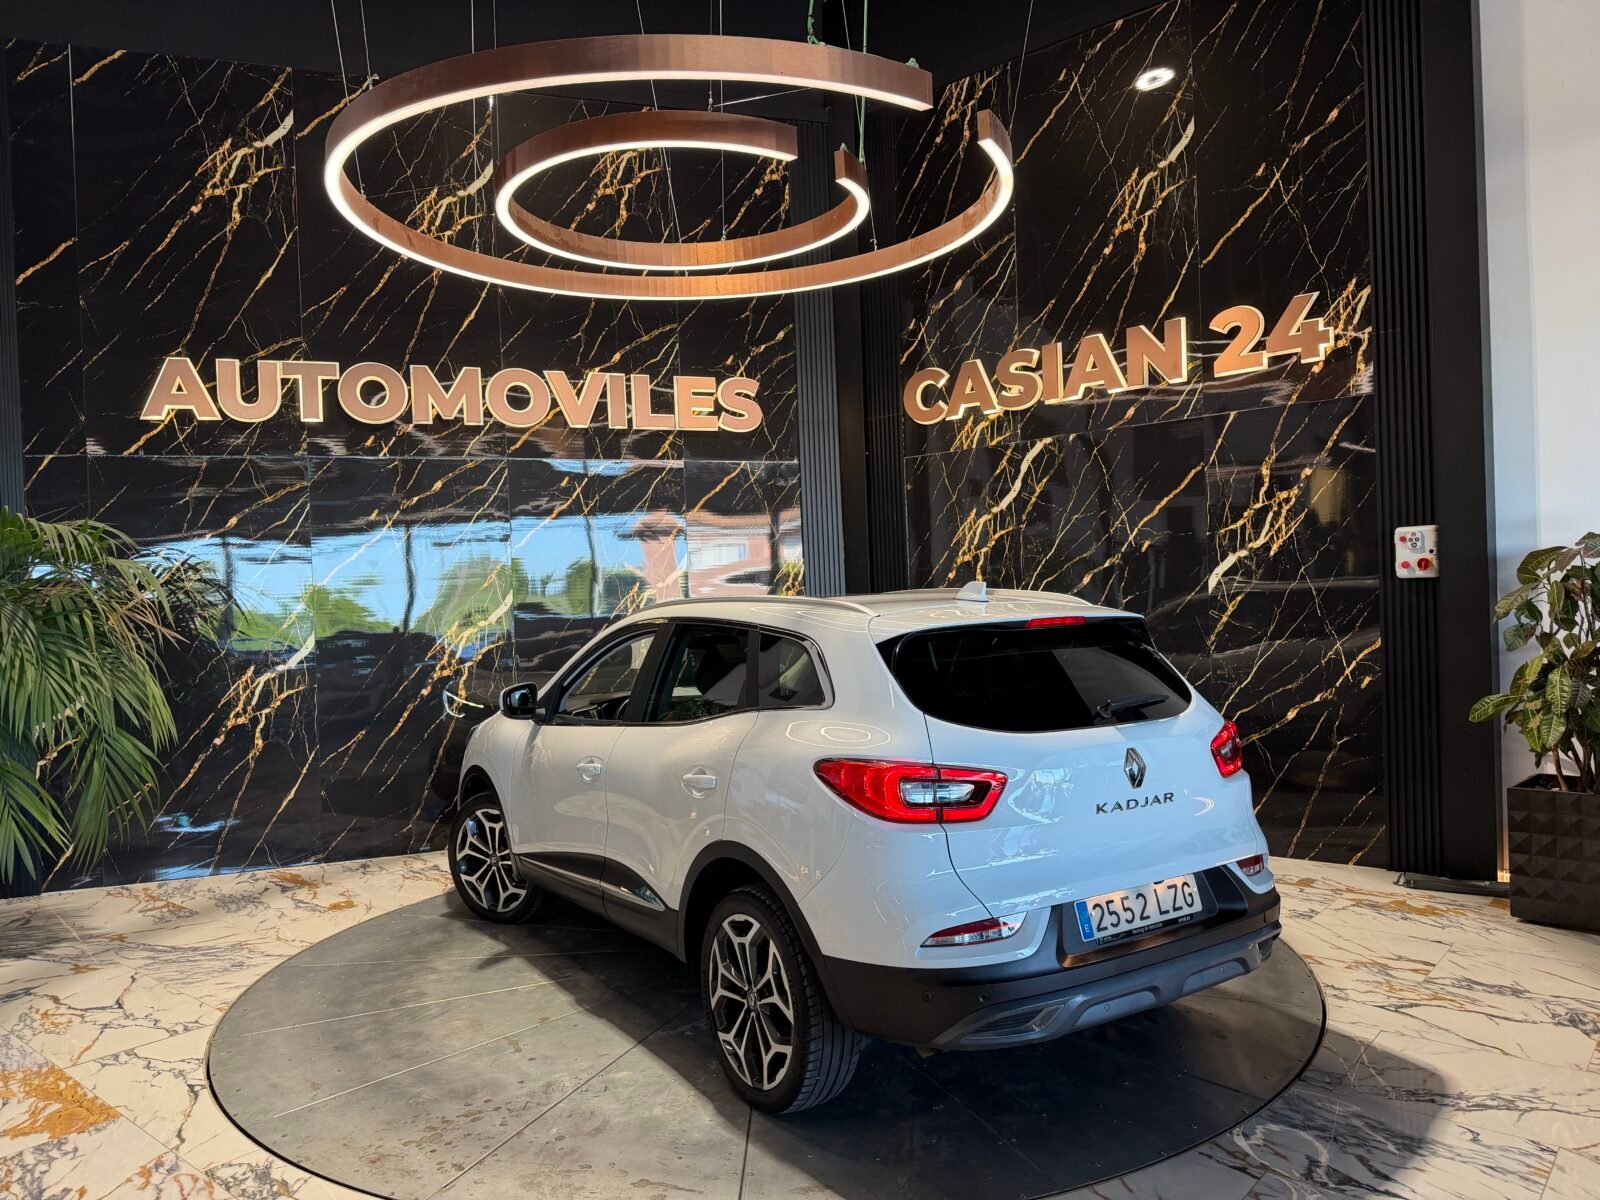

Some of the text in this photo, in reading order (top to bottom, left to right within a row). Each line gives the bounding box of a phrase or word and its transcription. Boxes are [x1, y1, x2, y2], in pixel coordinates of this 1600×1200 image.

[903, 291, 1334, 425] CASIAN 24
[139, 356, 764, 433] AUTOMOVILES
[1095, 792, 1175, 815] KADJAR
[1092, 881, 1195, 933] 2552 LZG
